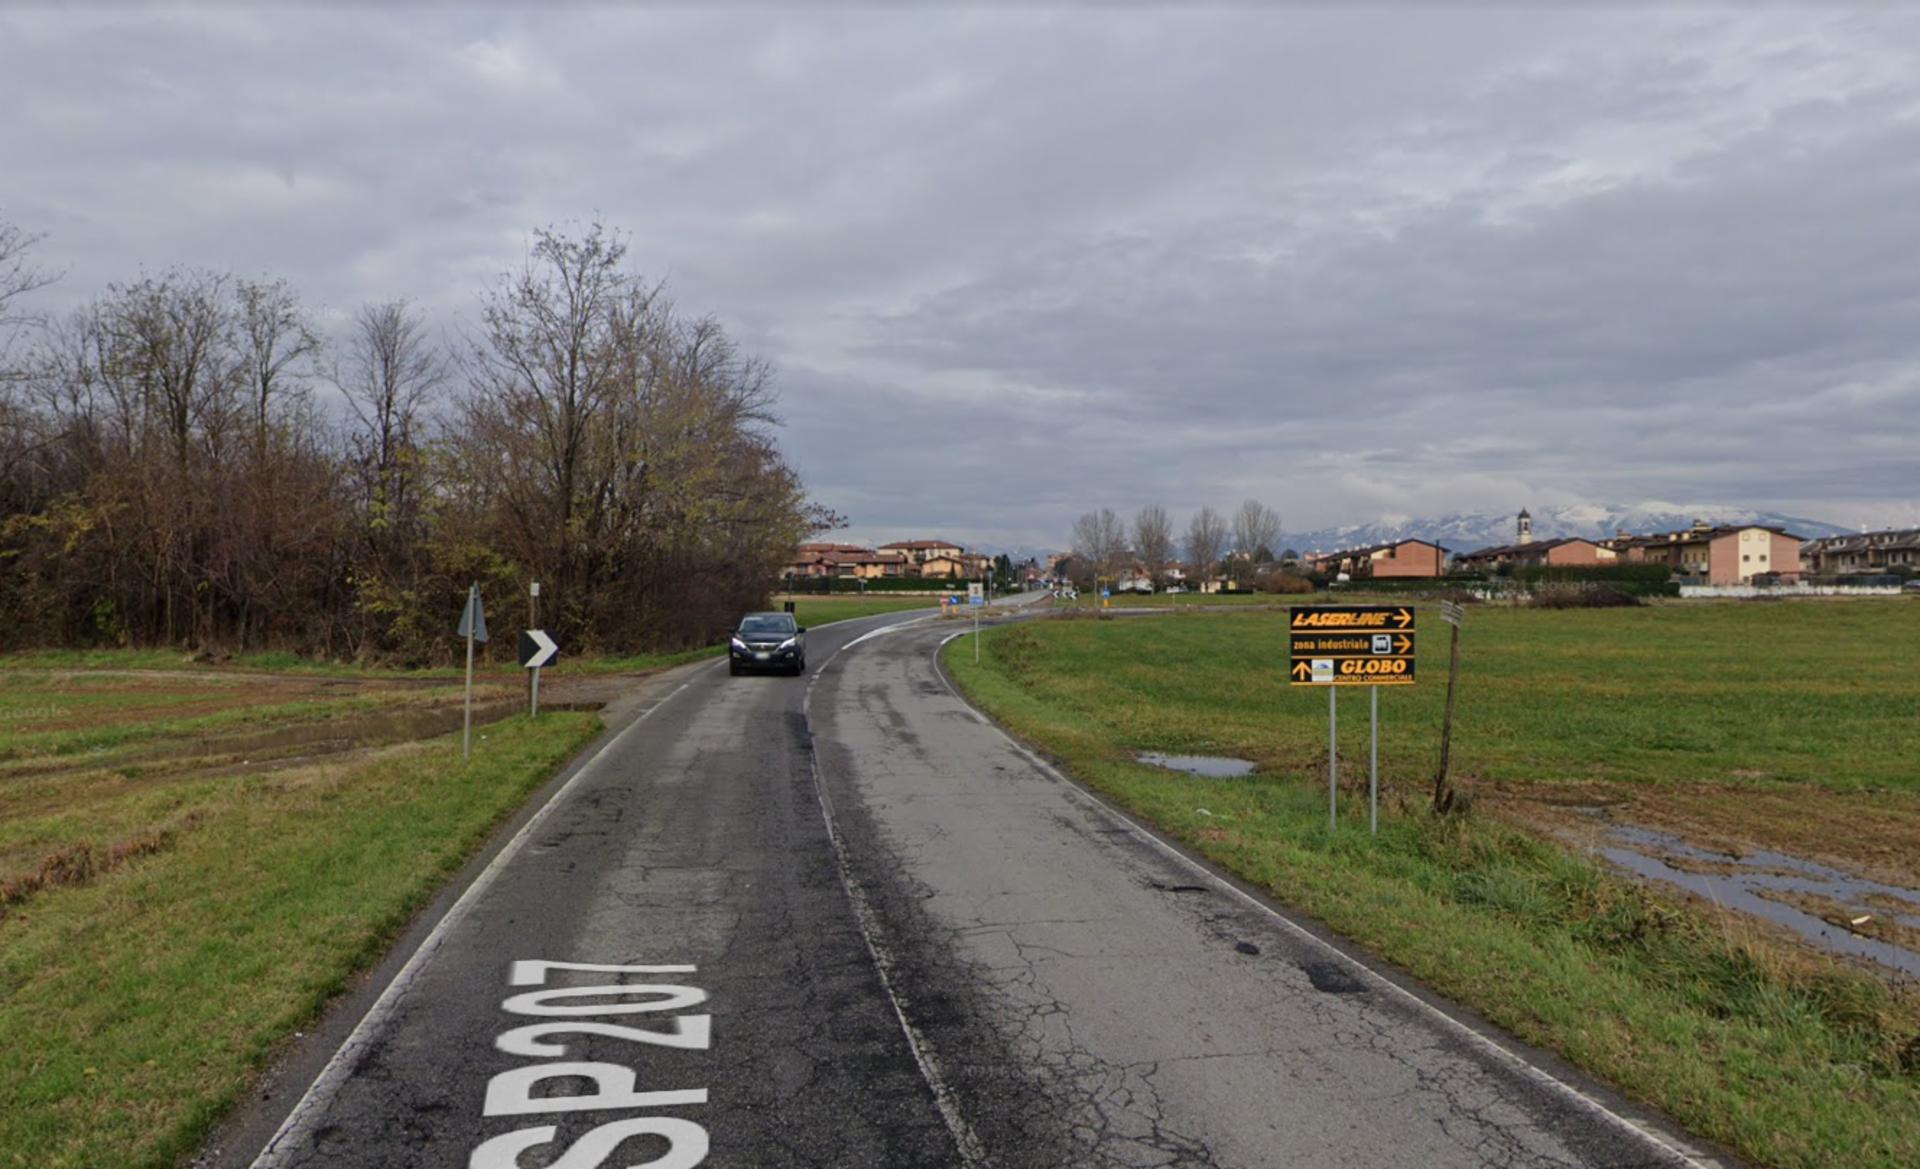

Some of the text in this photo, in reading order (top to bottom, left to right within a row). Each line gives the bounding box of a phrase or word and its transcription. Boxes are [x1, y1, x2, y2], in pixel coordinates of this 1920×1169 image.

[1292, 612, 1389, 626] LASERLINE
[1293, 639, 1370, 650] zona industriale
[1340, 659, 1407, 674] GLOBO
